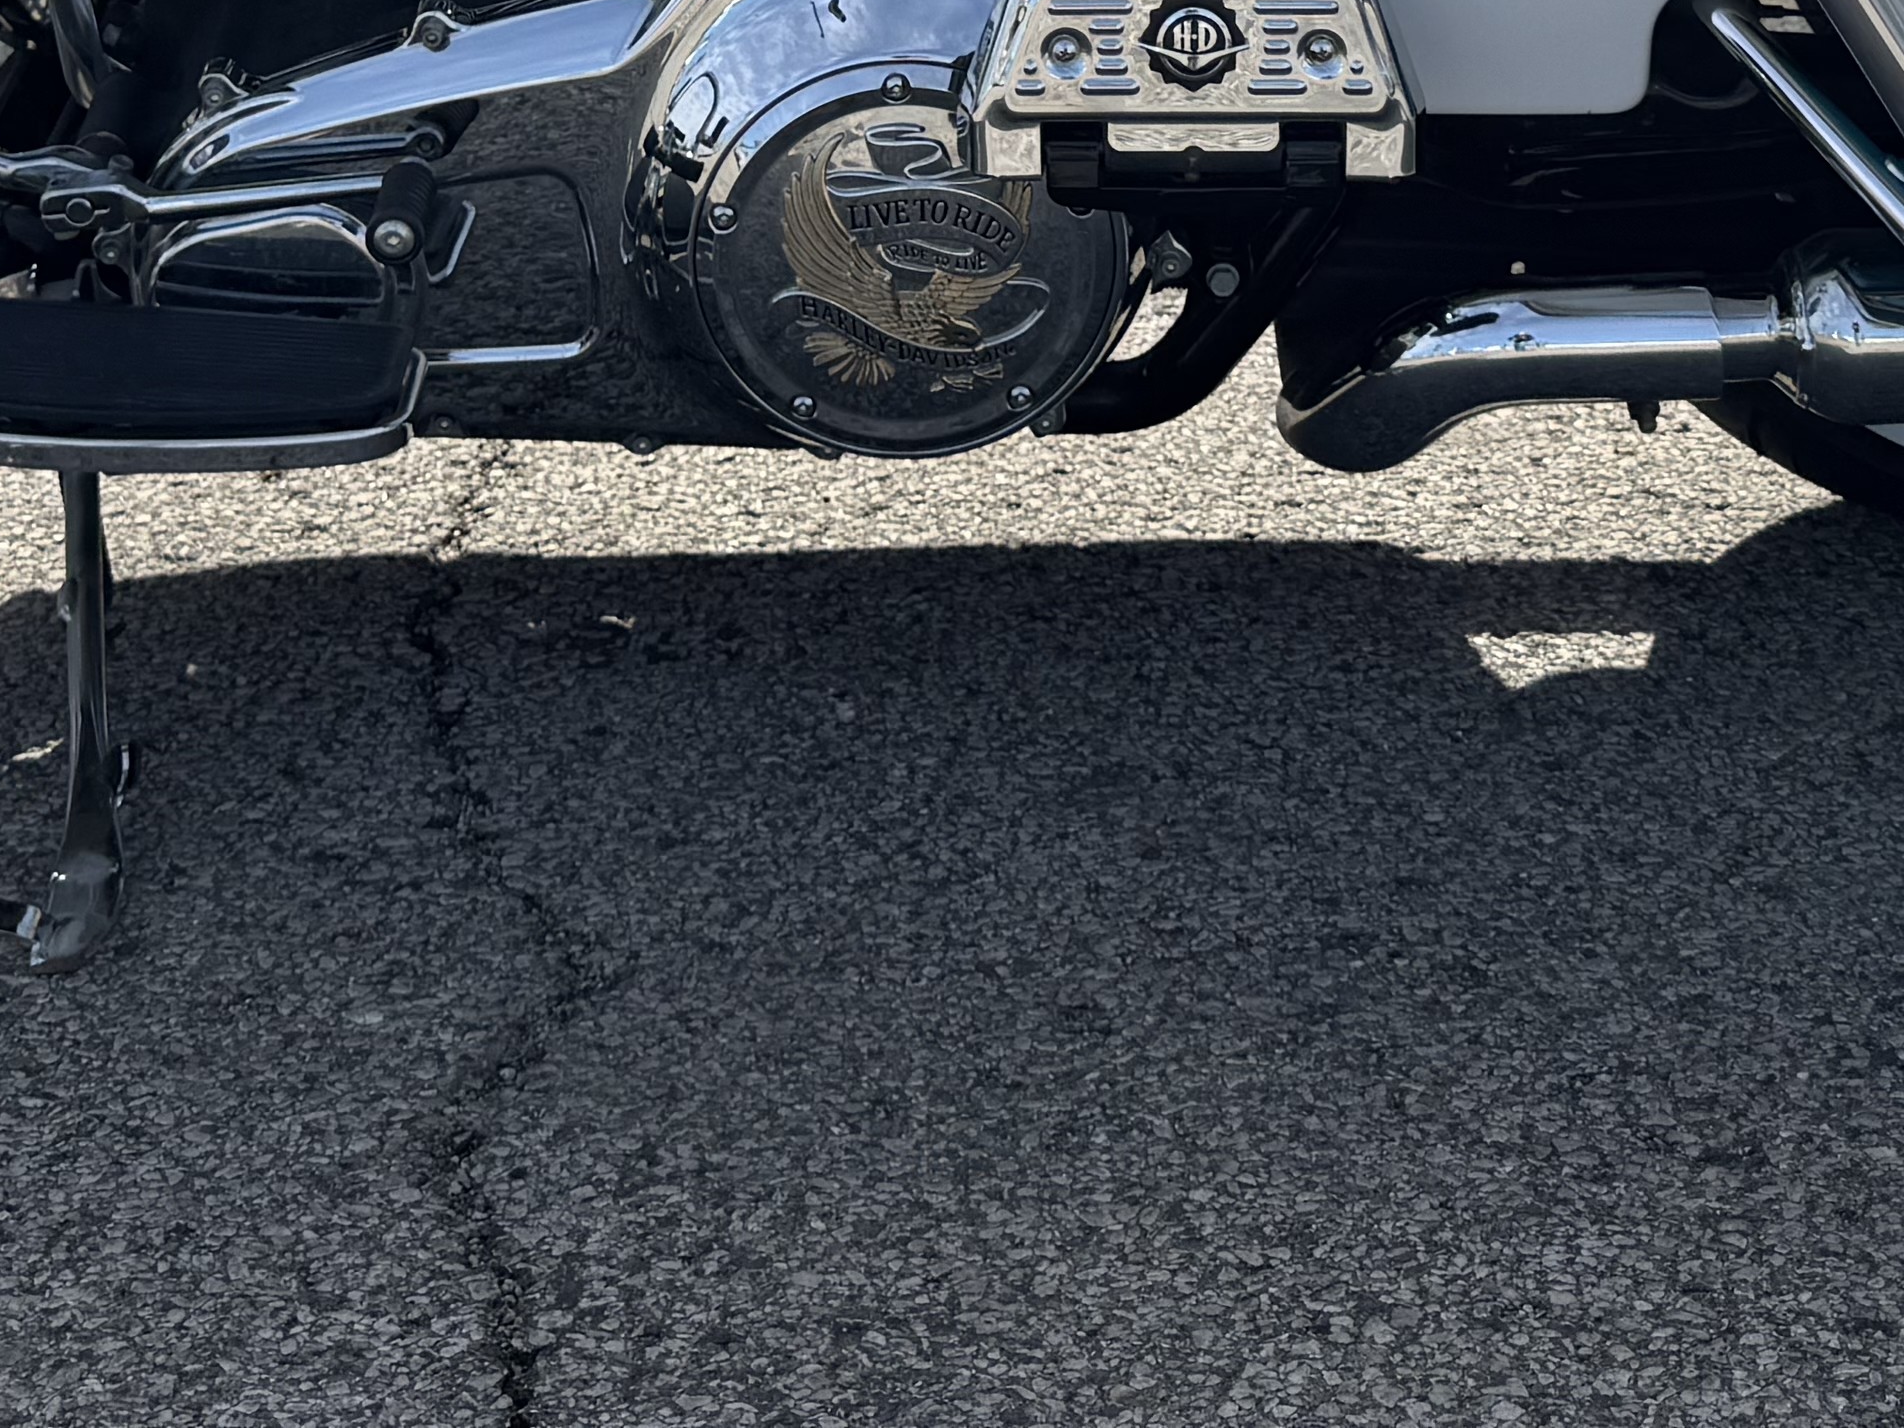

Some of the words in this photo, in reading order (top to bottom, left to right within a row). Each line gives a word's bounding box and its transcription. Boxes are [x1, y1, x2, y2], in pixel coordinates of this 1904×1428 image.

[847, 199, 911, 231] LIVE
[912, 197, 949, 225] TO
[952, 202, 1016, 255] RIDE
